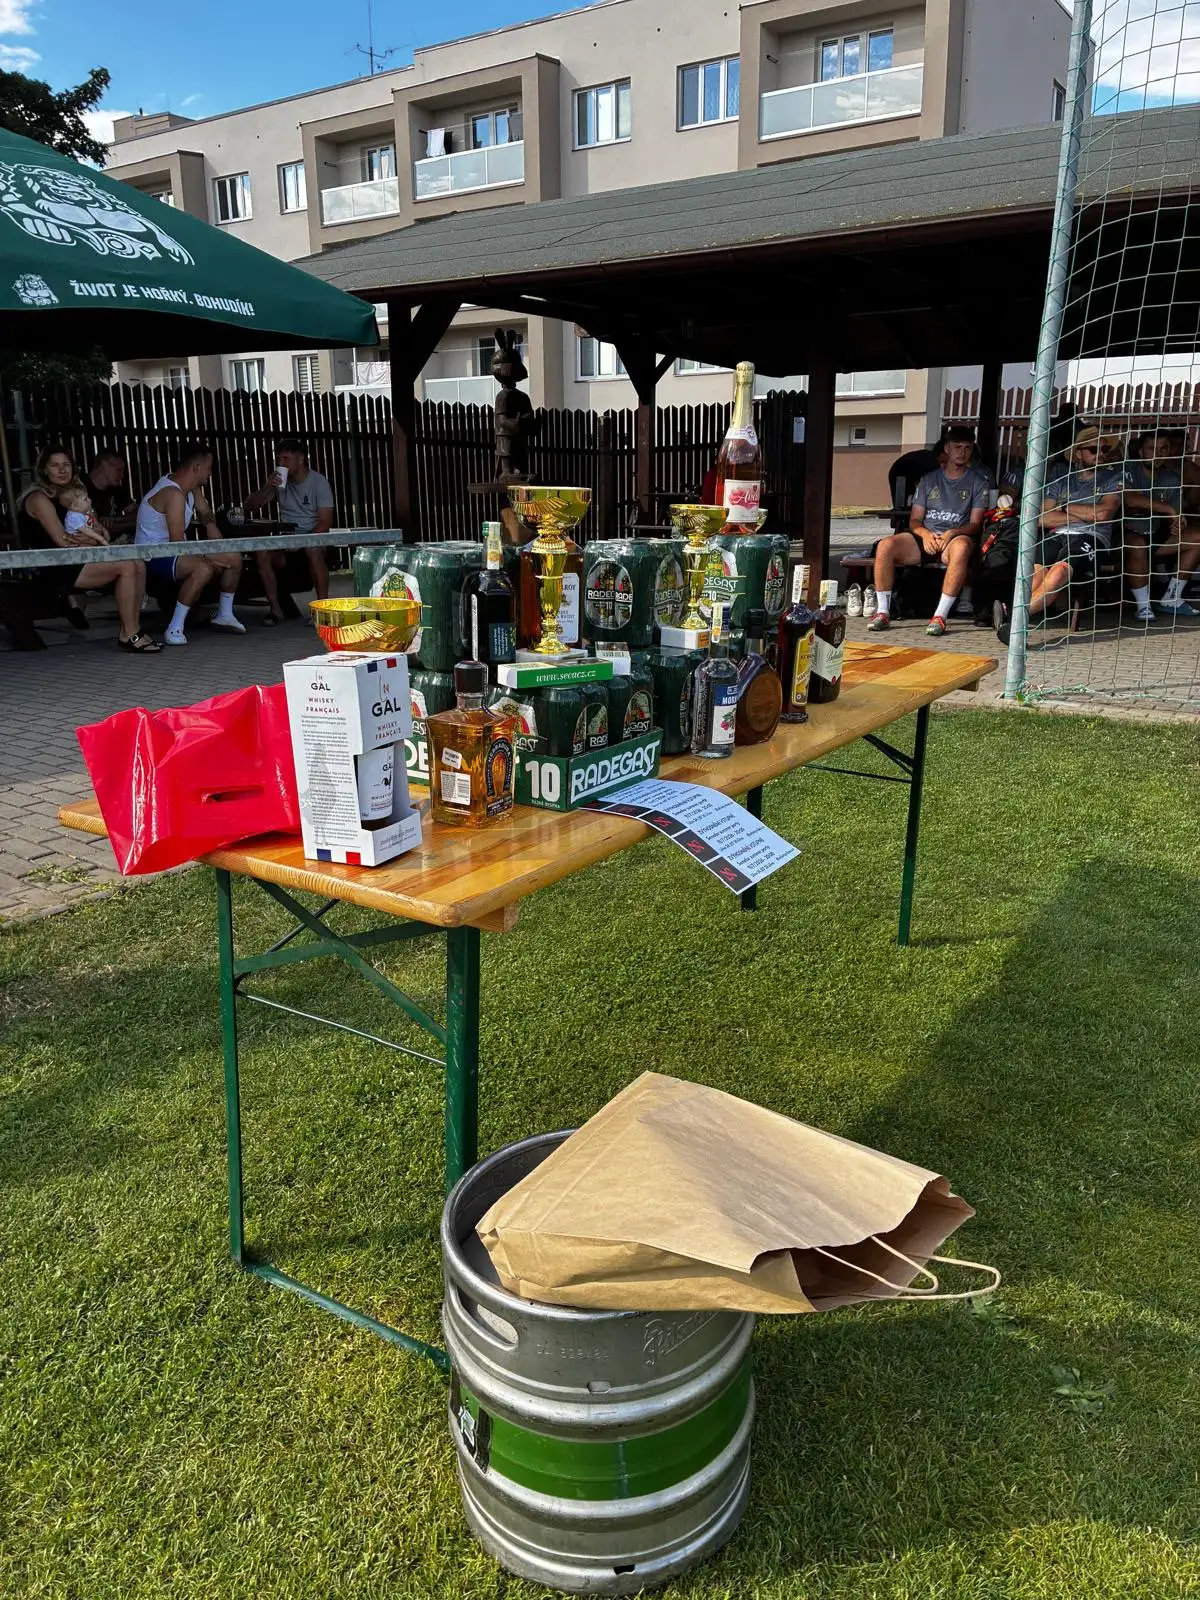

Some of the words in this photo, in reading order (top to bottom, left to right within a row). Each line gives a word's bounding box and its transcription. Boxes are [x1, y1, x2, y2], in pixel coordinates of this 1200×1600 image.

[70, 280, 117, 297] ŽIVOT
[122, 284, 141, 298] JE
[140, 287, 194, 305] HOŘKÝ.
[194, 293, 256, 316] BOHUDÍK!
[703, 577, 738, 593] DEGAST
[310, 682, 331, 692] GAL
[305, 706, 340, 715] FRANÇAIS
[371, 697, 402, 718] GAL
[377, 720, 398, 731] WHISKY
[375, 727, 402, 741] FRANÇAIS
[570, 740, 660, 804] RADEGAST
[525, 760, 561, 803] 10
